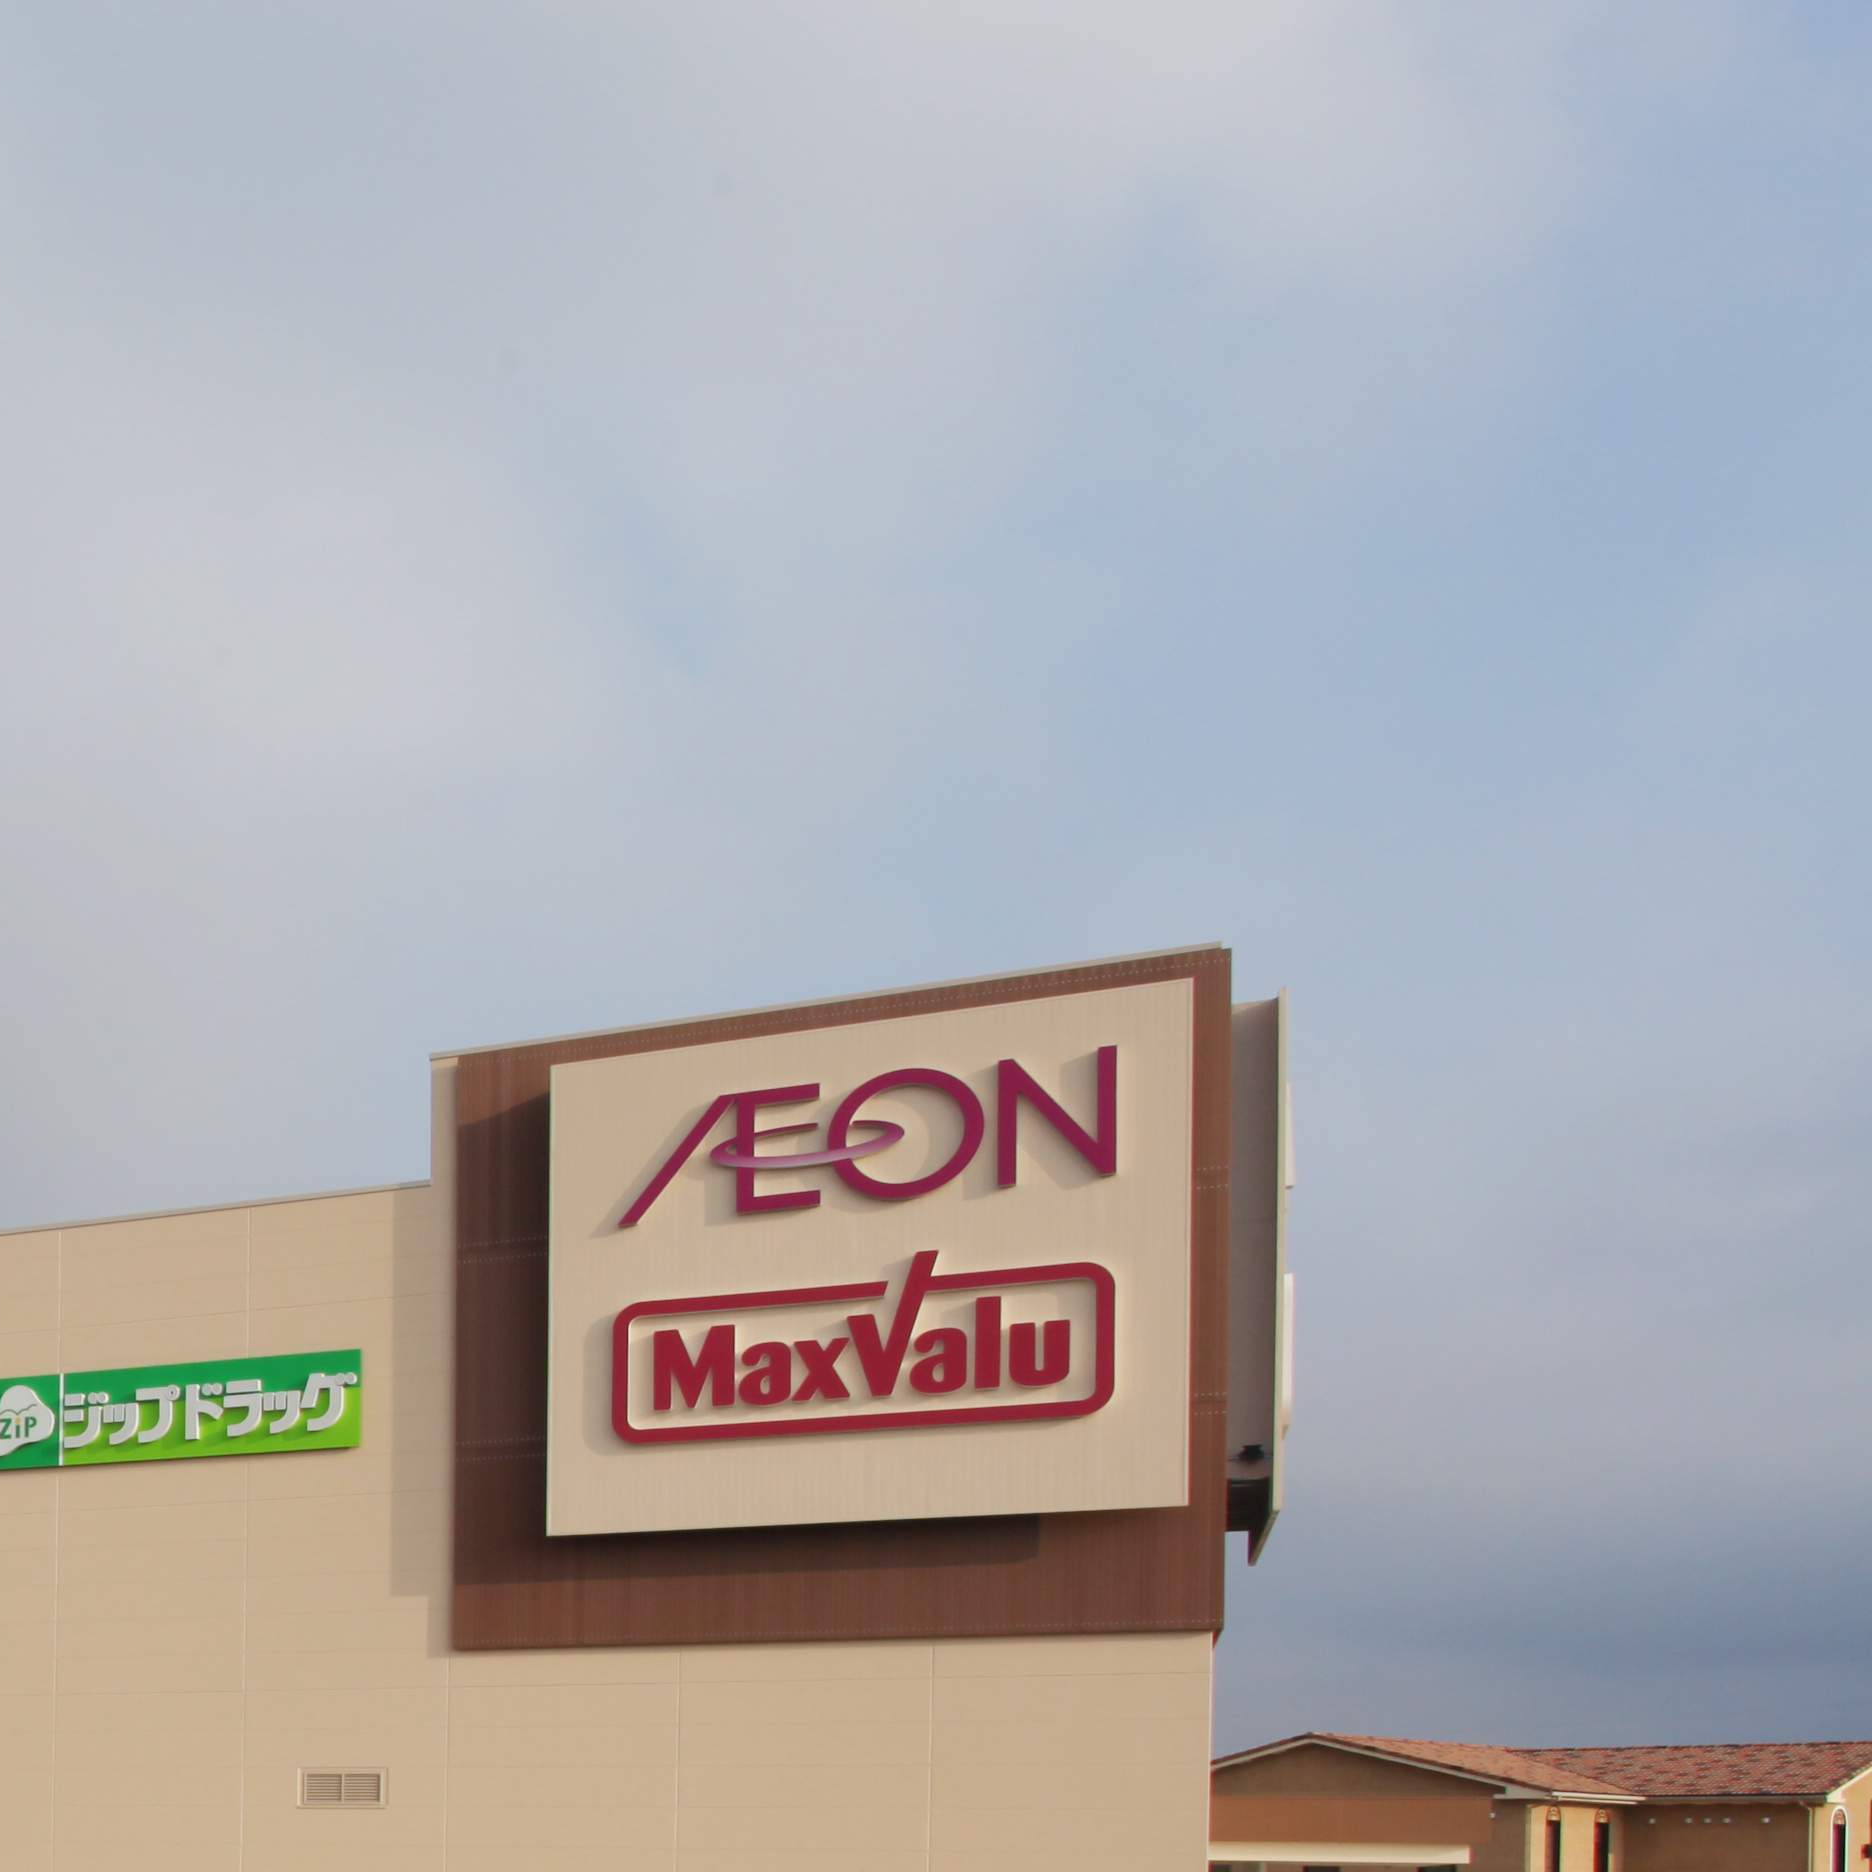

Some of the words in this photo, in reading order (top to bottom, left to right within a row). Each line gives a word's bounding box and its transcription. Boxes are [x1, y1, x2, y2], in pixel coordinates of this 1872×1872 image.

[654, 1250, 1070, 1412] MaxValu
[62, 1372, 358, 1449] ジップドラッグ
